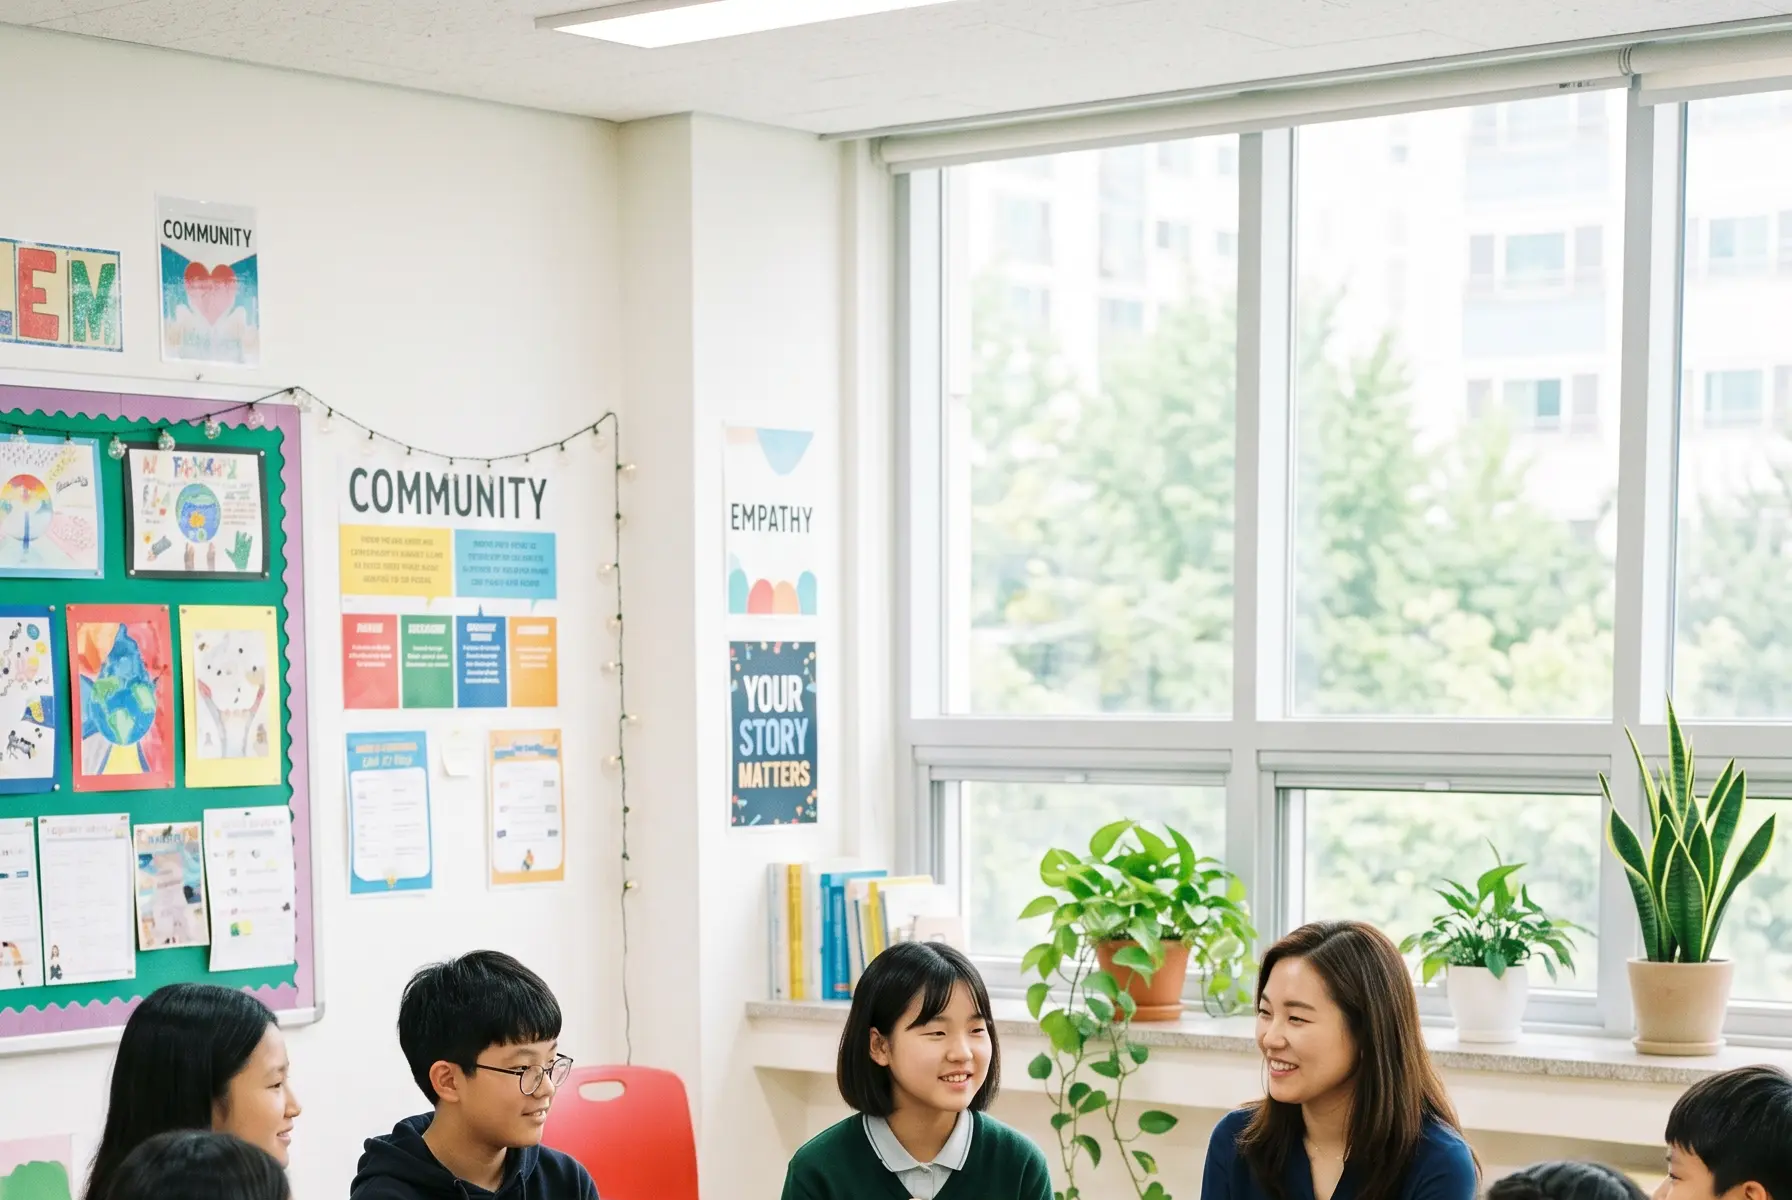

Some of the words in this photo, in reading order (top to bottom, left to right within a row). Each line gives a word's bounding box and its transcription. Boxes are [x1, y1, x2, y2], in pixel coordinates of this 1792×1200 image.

[163, 219, 252, 248] COMMUNITY
[0, 247, 116, 345] EM
[349, 467, 547, 520] COMMUNITY
[731, 503, 813, 533] EMPATHY
[743, 674, 804, 713] YOUR
[739, 718, 809, 756] STORY
[738, 761, 811, 788] MATTERS
